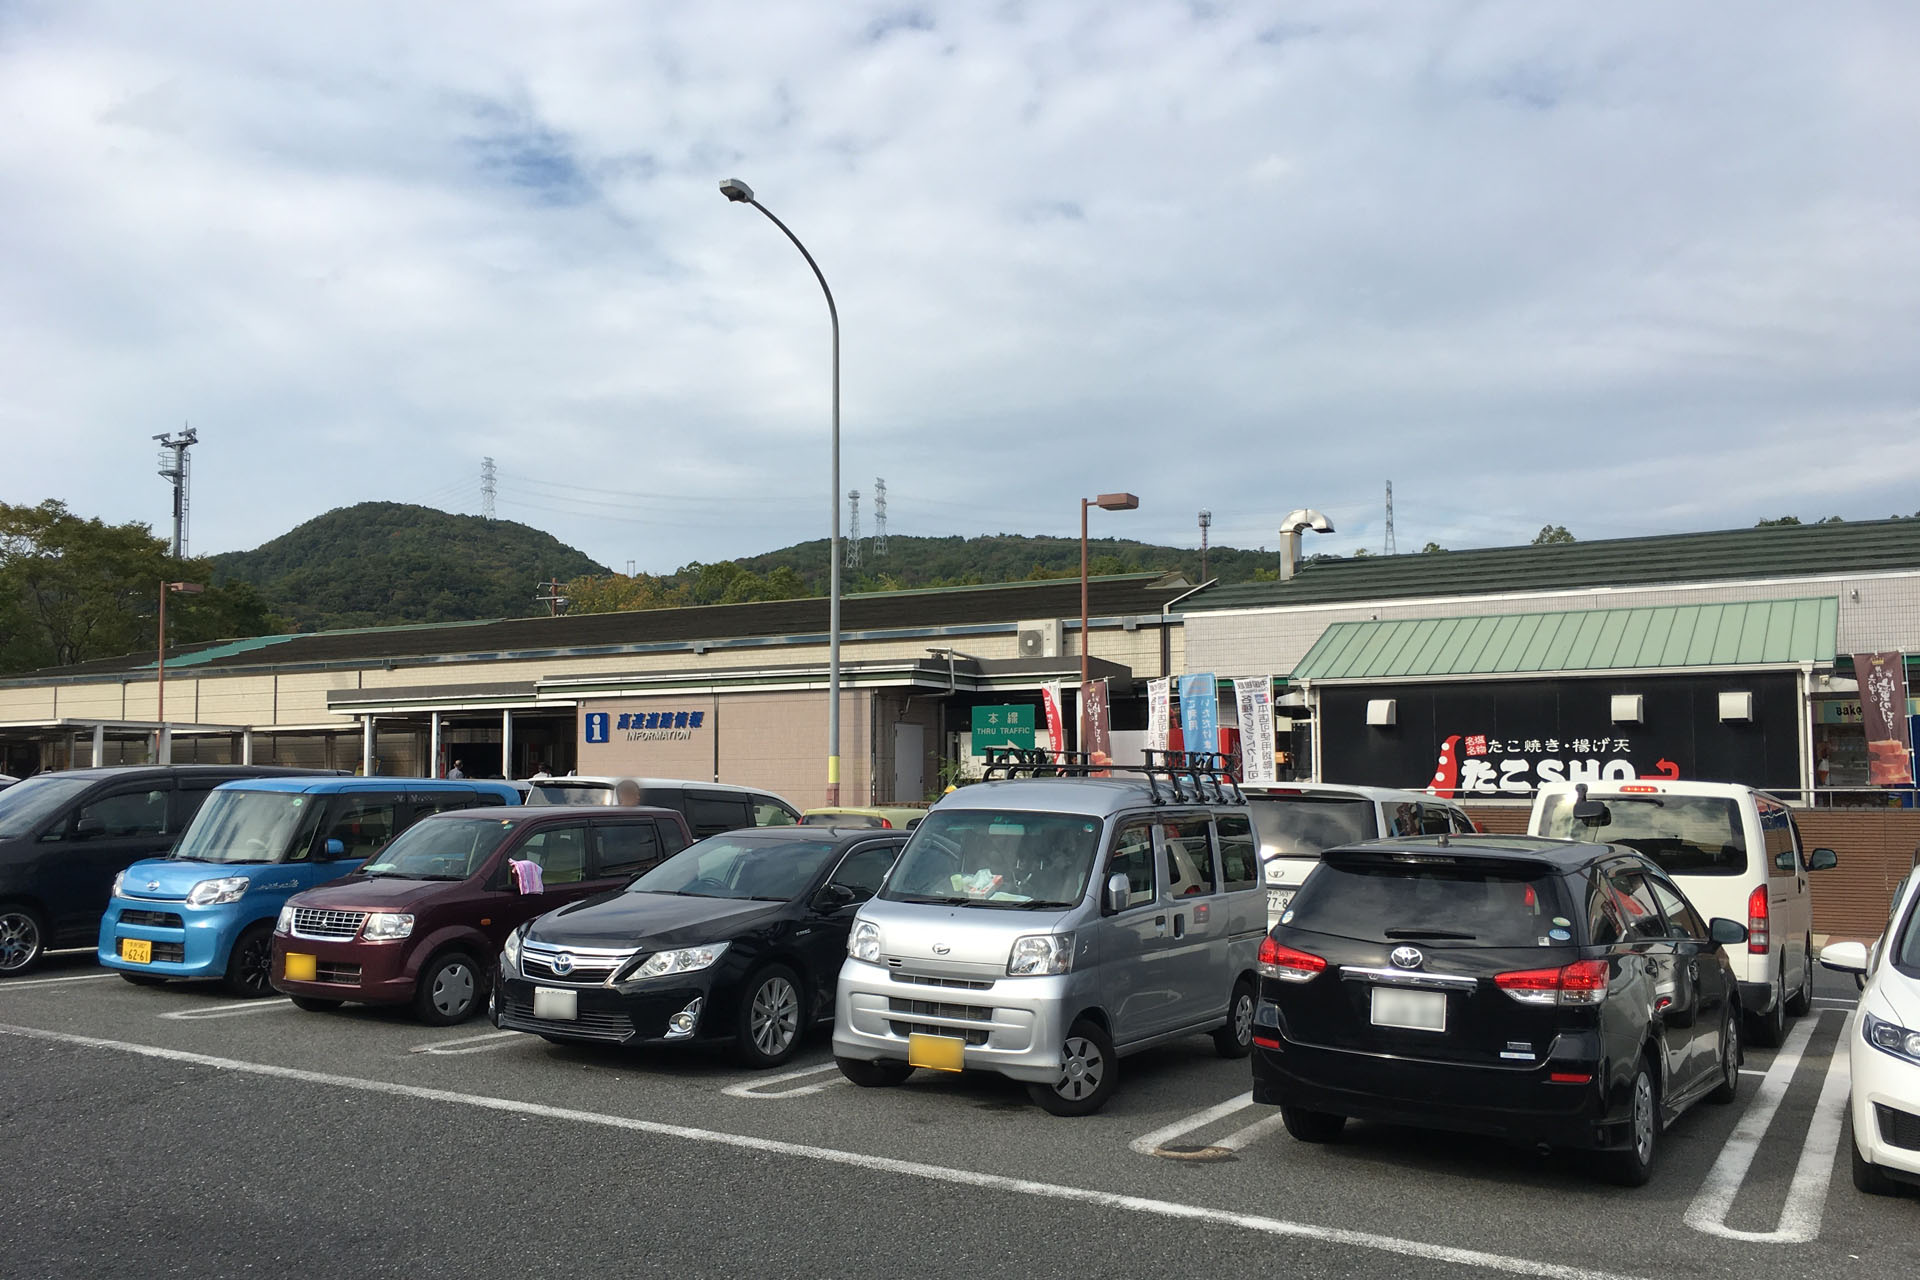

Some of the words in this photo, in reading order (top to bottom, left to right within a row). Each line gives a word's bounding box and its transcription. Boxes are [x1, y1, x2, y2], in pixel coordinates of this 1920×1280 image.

[1044, 695, 1052, 712] Tax
[1046, 713, 1054, 735] Free
[627, 731, 691, 741] INFORMATION
[1000, 727, 1030, 735] TRAFFIC
[128, 949, 149, 962] 62-61
